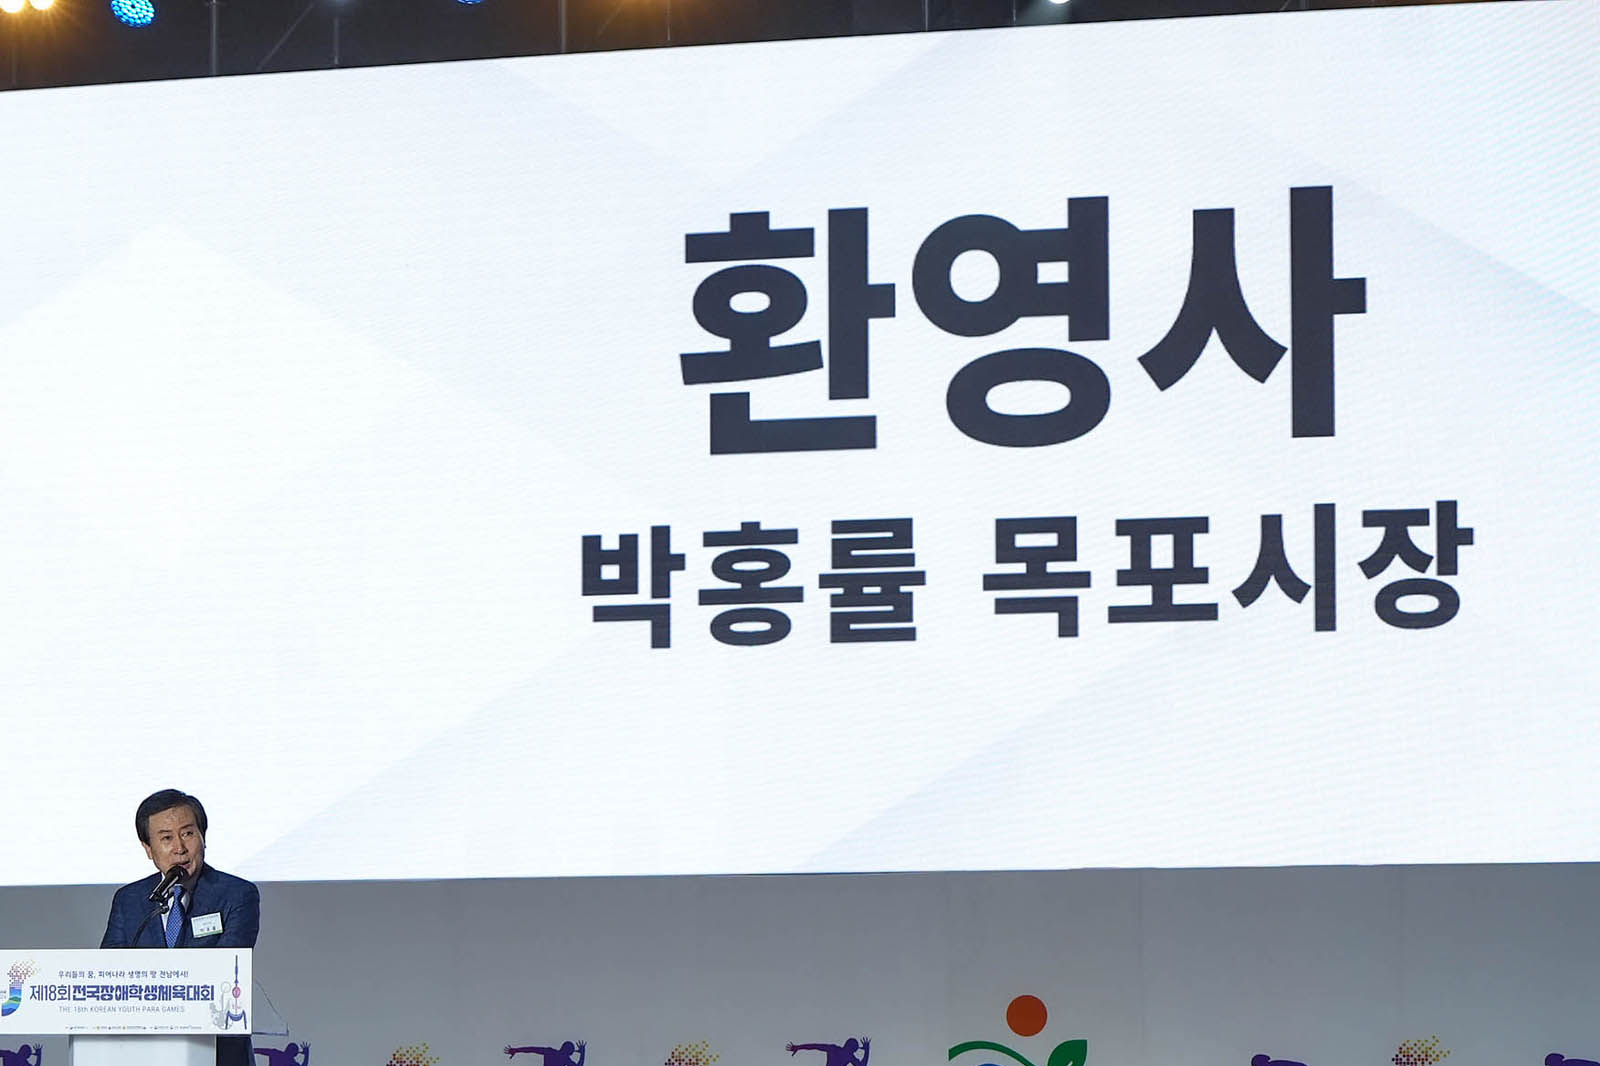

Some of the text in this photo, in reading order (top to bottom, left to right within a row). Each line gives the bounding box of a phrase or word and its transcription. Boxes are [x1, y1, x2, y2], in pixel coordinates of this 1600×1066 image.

[679, 185, 1367, 455] 환영사
[581, 500, 1474, 648] 박홍률 목포시장
[29, 984, 215, 1001] 제18회 전국장애학생체육대회
